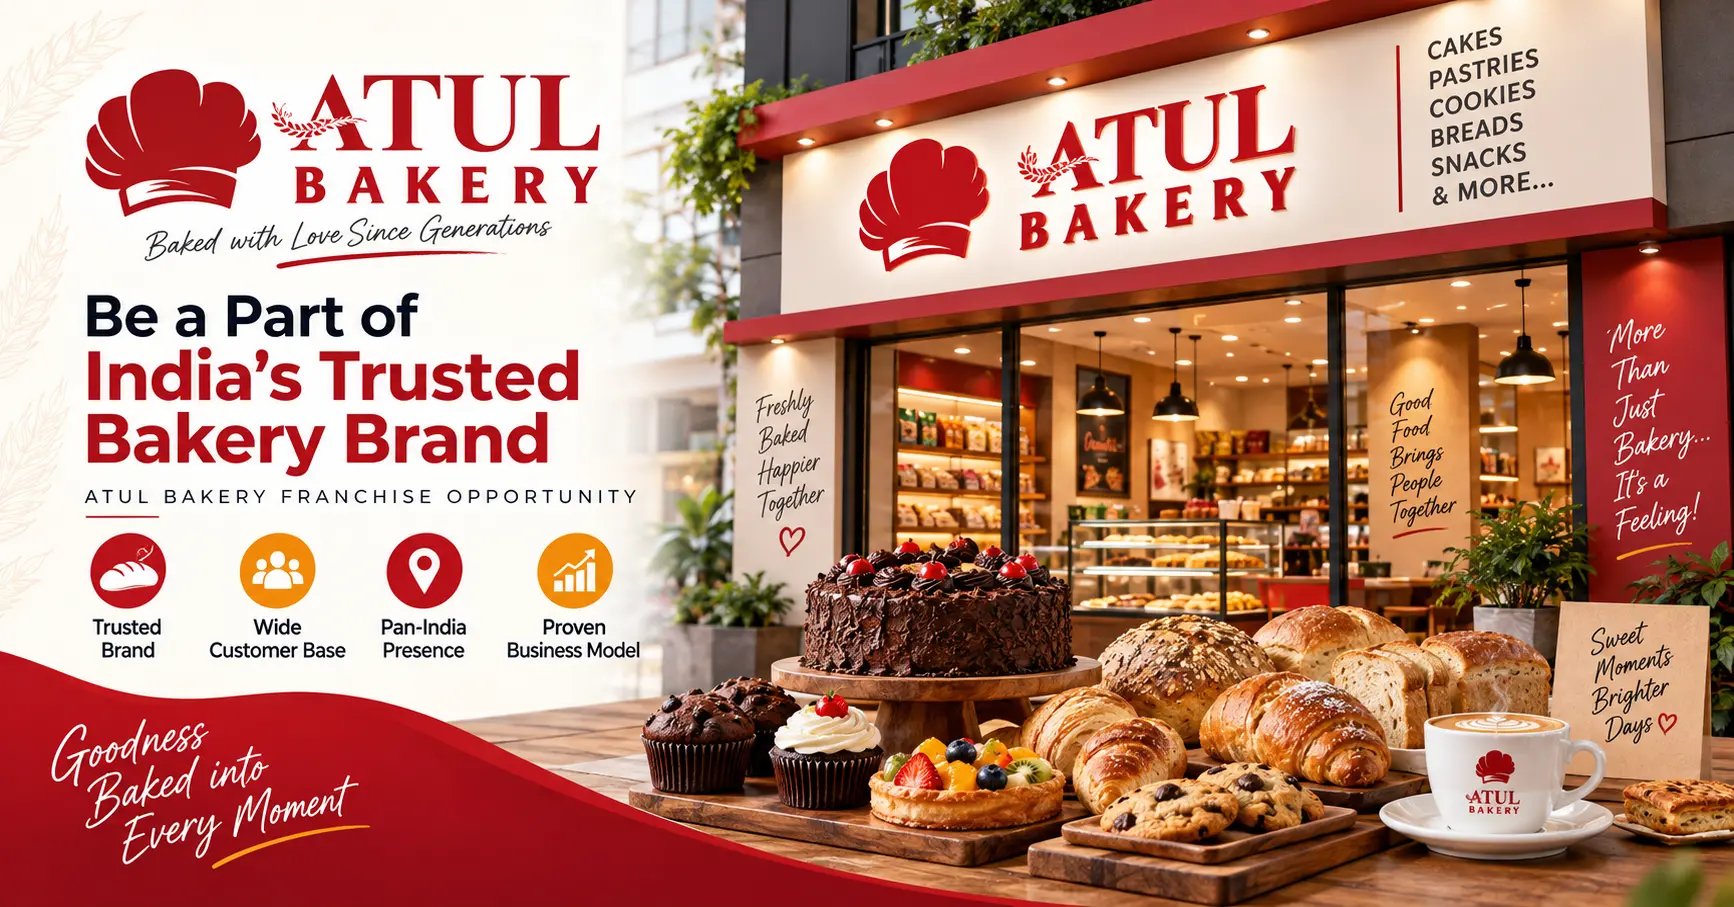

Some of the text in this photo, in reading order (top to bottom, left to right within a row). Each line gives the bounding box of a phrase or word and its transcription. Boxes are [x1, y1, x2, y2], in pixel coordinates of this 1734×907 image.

[1428, 26, 1502, 60] CAKES
[1429, 48, 1539, 90] PASTRIES
[1429, 79, 1536, 118] COOKIES
[1030, 84, 1296, 198] ATUL
[1431, 112, 1523, 148] BREADS
[1431, 141, 1526, 177] SNACKS
[1432, 171, 1554, 206] & MORE...
[1019, 166, 1296, 251] BAKERY
[1611, 355, 1670, 390] Than
[755, 387, 815, 423] Freshly
[1389, 388, 1434, 417] Good
[1613, 388, 1665, 428] Just
[758, 418, 810, 454] Baked
[1392, 414, 1433, 443] Food
[1613, 427, 1711, 466] Bakery...
[757, 456, 821, 486] Happier
[1389, 445, 1444, 470] Brings
[1390, 468, 1443, 498] People
[1613, 469, 1670, 502] It's a
[757, 484, 825, 521] Together
[1390, 495, 1457, 527] Together
[1615, 491, 1701, 540] Feeling!
[1591, 620, 1649, 656] Sweet
[1594, 644, 1674, 684] Moments
[1592, 677, 1670, 717] Brighter
[1605, 715, 1654, 744] Days
[1468, 790, 1521, 805] ATUL
[1468, 806, 1520, 815] BAKERY
